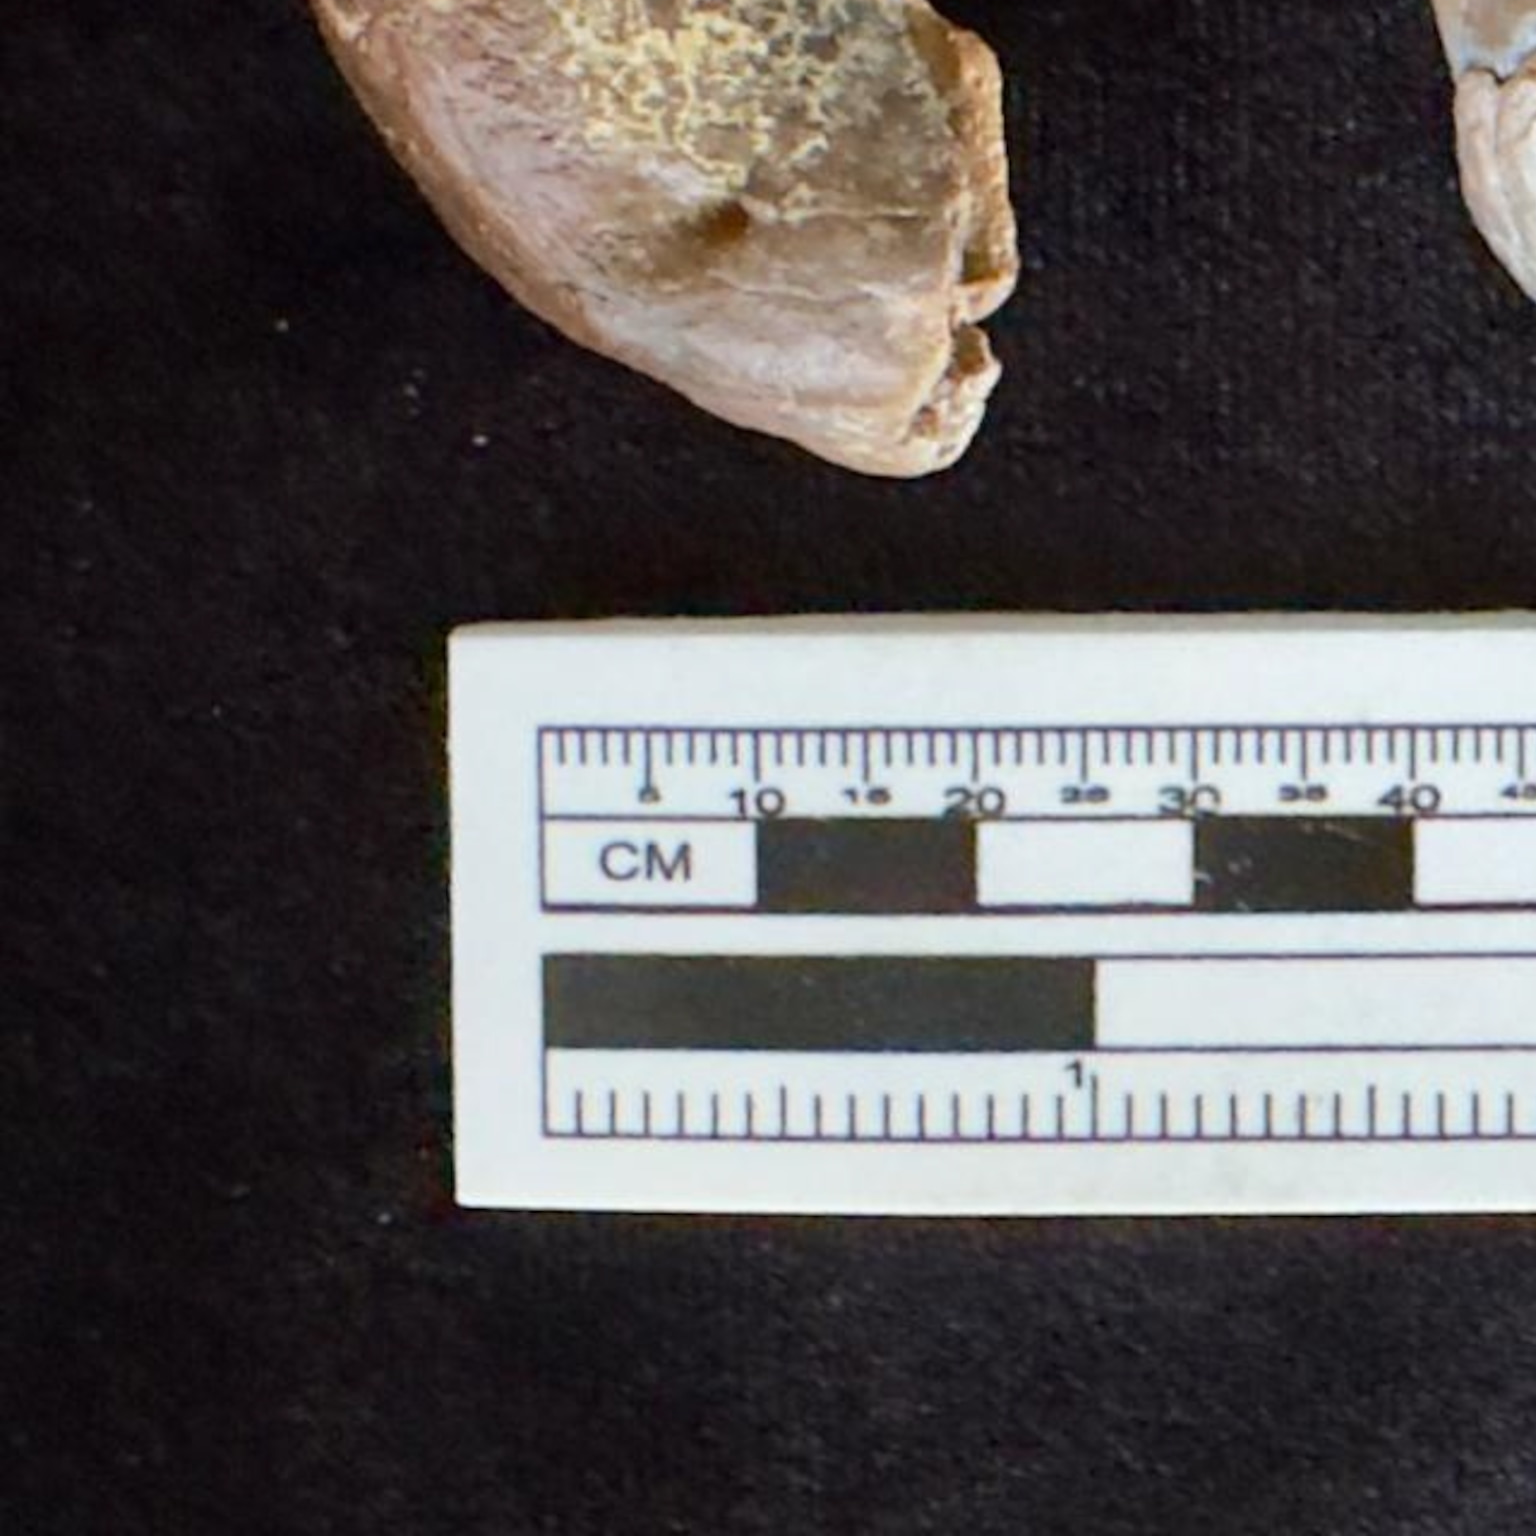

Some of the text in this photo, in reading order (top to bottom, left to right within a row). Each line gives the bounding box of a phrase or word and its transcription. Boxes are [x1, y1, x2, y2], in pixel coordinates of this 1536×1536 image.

[730, 787, 786, 818] 10
[944, 787, 1006, 817] 20
[1158, 786, 1221, 816] 30
[1378, 783, 1441, 814] 40
[600, 840, 692, 881] CM
[1064, 1058, 1082, 1089] 1
